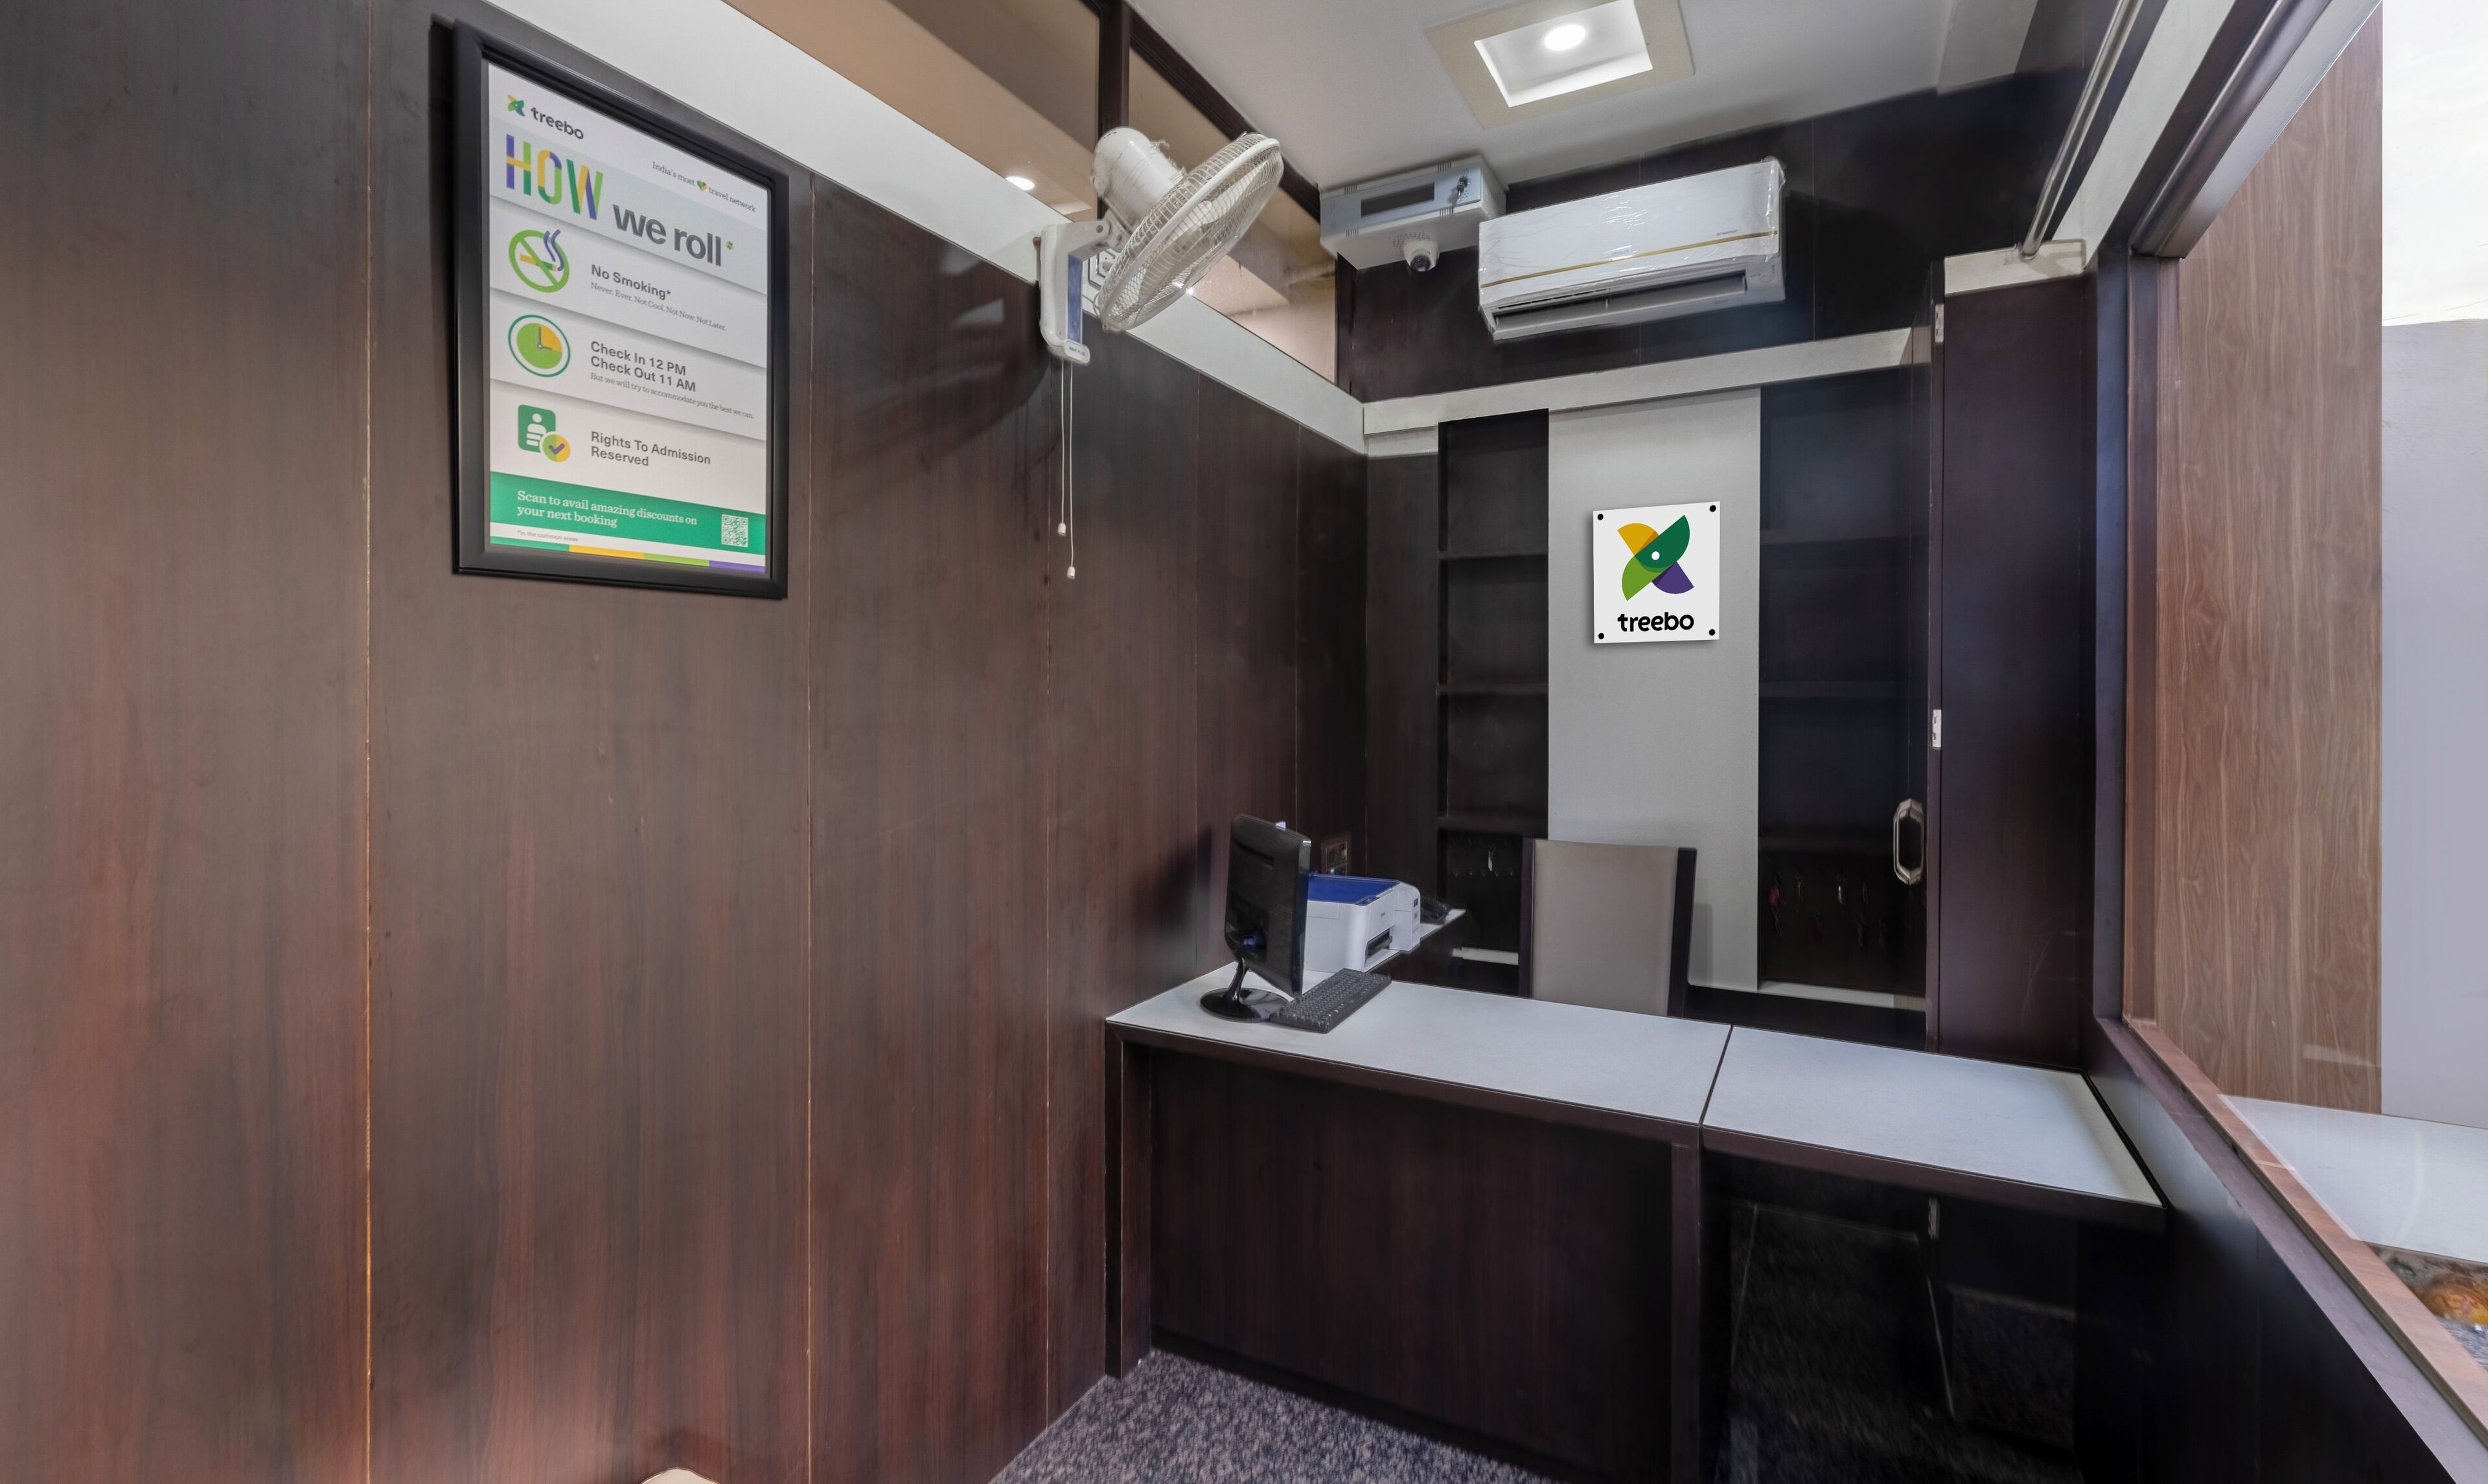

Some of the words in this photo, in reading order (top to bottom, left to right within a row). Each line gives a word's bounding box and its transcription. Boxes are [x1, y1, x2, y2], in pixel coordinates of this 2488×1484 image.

[531, 107, 584, 139] treebo
[506, 133, 603, 220] HOW
[613, 204, 666, 245] we
[652, 161, 676, 178] India's
[678, 173, 695, 186] most
[708, 187, 728, 201] travel
[730, 196, 756, 212] network
[592, 264, 609, 279] No
[591, 282, 614, 295] Never.
[615, 290, 633, 301] Ever.
[634, 296, 648, 306] Not
[648, 301, 665, 312] Cool.
[666, 306, 680, 317] Not
[680, 310, 696, 321] Now.
[697, 315, 709, 326] Not
[709, 320, 726, 331] Later.
[591, 341, 631, 361] Check
[634, 353, 645, 365] In
[650, 358, 663, 370] 12
[667, 361, 686, 376] PM
[591, 356, 631, 376] Check
[634, 367, 656, 382] Out
[660, 374, 672, 386] 11
[676, 378, 696, 392] AM
[590, 372, 604, 382] But
[616, 380, 630, 389] will
[631, 383, 642, 393] try
[651, 389, 696, 404] accommodate
[709, 402, 719, 411] the
[719, 404, 732, 414] best
[742, 411, 754, 419] can.
[591, 431, 631, 449] Rights
[634, 440, 648, 452] To
[651, 444, 711, 464] Admission
[591, 446, 649, 466] Reserved
[517, 490, 547, 505] Scan
[549, 495, 561, 506] to
[562, 499, 589, 510] avail
[590, 504, 636, 518] amazing
[636, 508, 684, 523] discounts
[685, 517, 698, 526] on
[517, 505, 545, 517] your
[547, 510, 571, 521] next
[574, 513, 617, 529] booking
[1617, 611, 1695, 632] treebo
